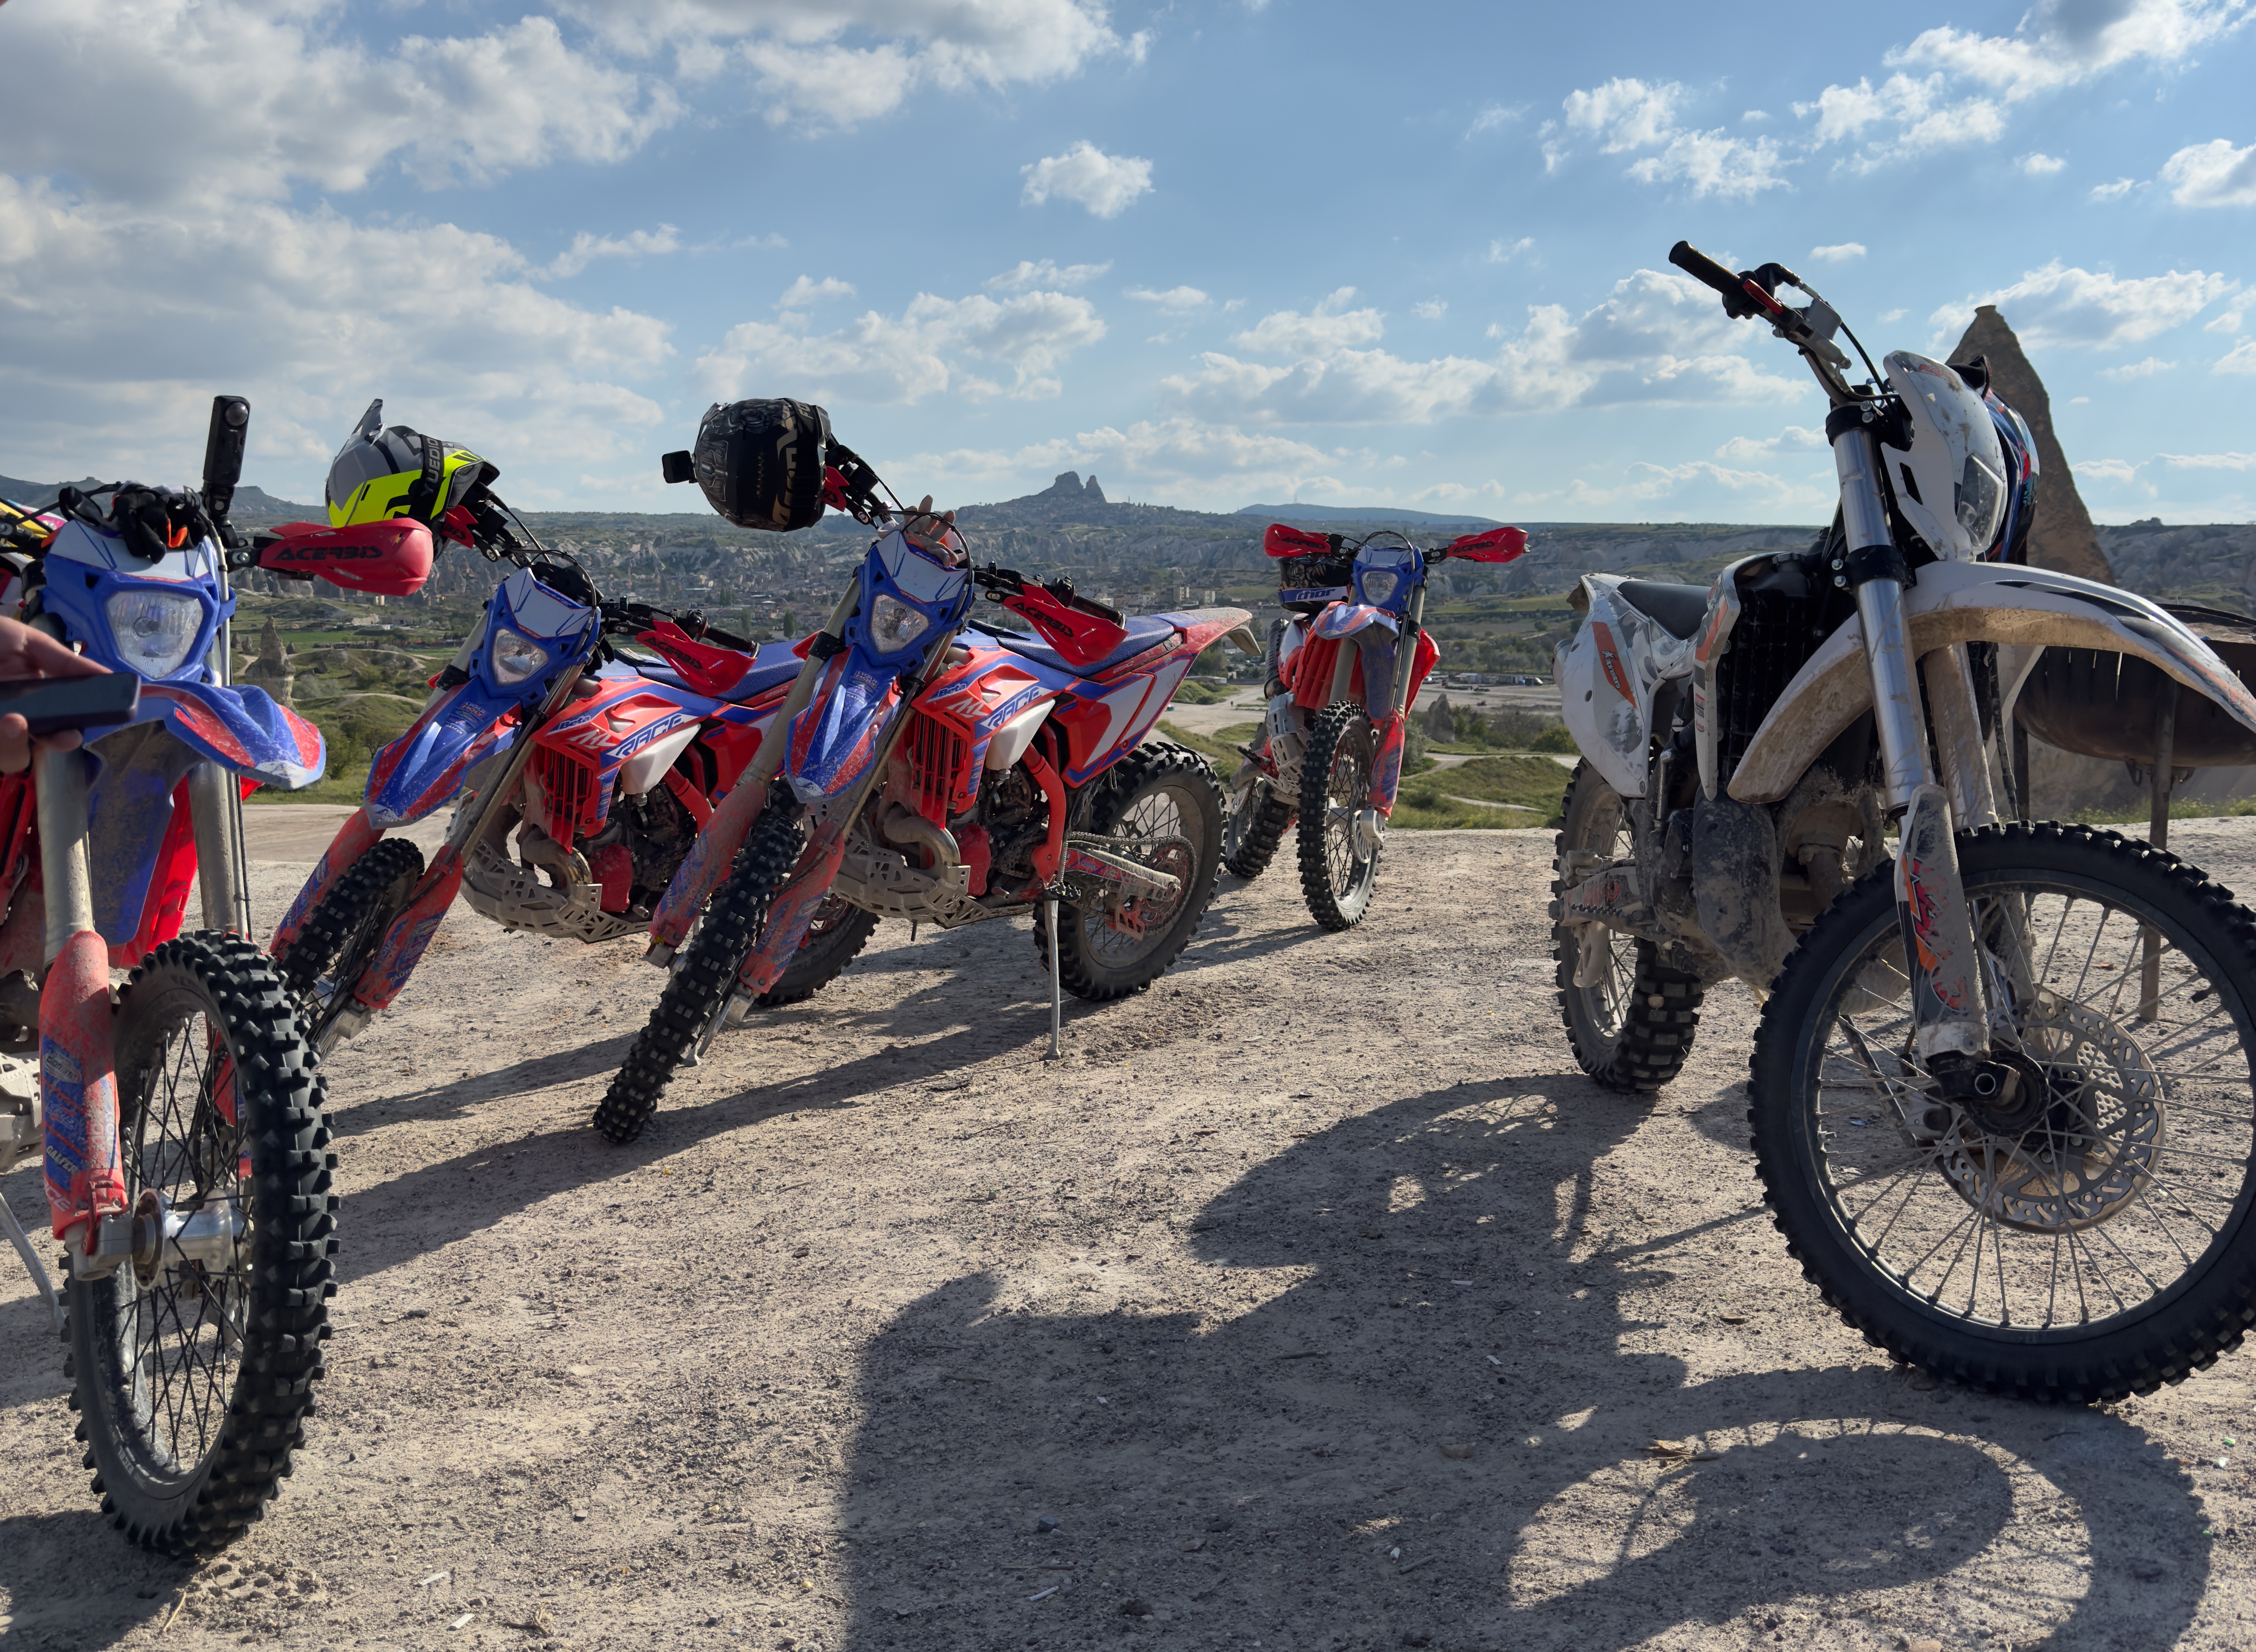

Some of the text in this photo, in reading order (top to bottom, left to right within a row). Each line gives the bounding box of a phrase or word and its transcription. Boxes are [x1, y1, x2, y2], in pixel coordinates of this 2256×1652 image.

[1297, 588, 1336, 601] thor
[765, 686, 788, 699] 250
[939, 683, 966, 696] Beta
[987, 686, 1042, 727] RACE
[559, 715, 591, 729] Beta
[615, 714, 685, 757] RACE
[46, 1145, 81, 1175] GALFER
